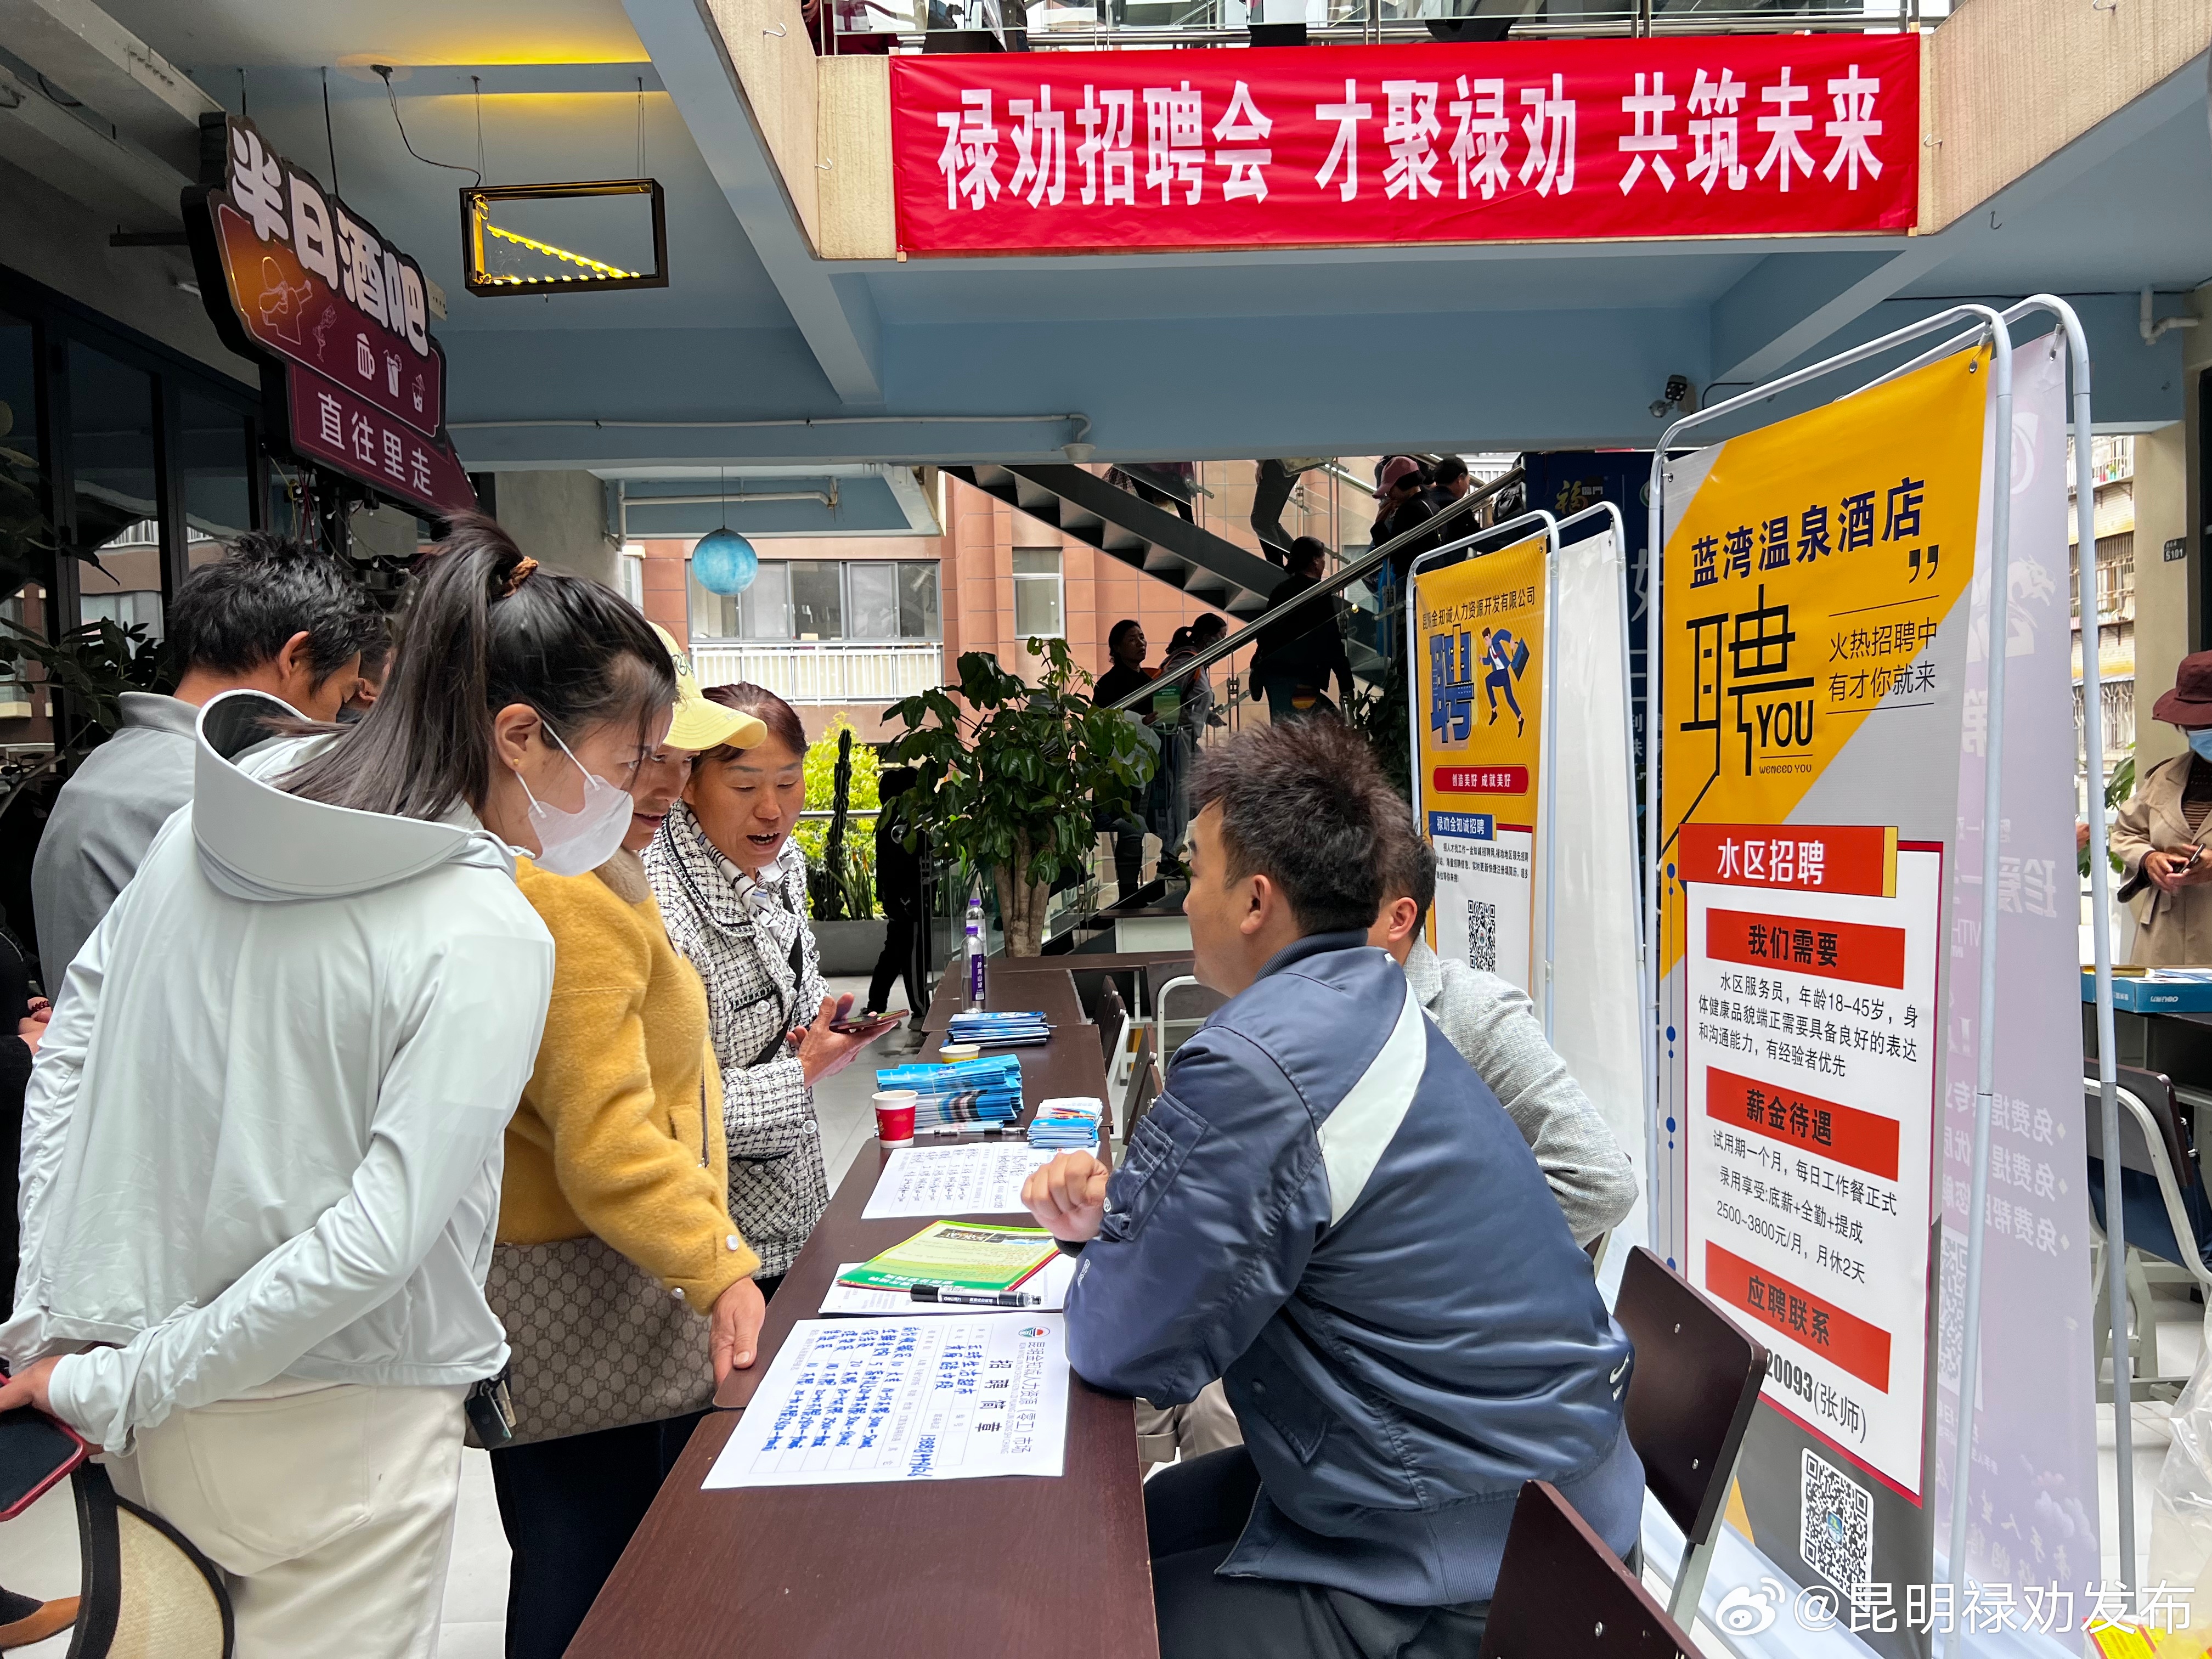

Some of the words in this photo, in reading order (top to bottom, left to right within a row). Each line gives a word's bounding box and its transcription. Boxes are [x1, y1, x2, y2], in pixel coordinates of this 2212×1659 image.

[936, 78, 1274, 211] 禄劝招聘会
[1314, 75, 1577, 201] 才聚禄劝
[1618, 64, 1883, 195] 共筑未来
[233, 127, 430, 357] 半日酒吧
[318, 391, 433, 496] 直往里走
[1690, 476, 1925, 589] 蓝湾温泉酒店
[1829, 617, 1937, 662] 火热招聘中
[1429, 624, 1474, 743] 聘
[1680, 584, 1814, 776] 聘
[1827, 661, 1936, 702] 有才你就来
[1756, 699, 1814, 748] YOU
[1452, 774, 1477, 787] 创造美好
[1481, 774, 1511, 787] 成就美好
[1795, 764, 1812, 774] YOU
[1437, 816, 1485, 835] 禄劝金知诚招聘
[1717, 837, 1824, 885] 水区招聘
[1748, 924, 1838, 968] 我们需要
[1699, 994, 1917, 1062] 体健康品貌端正需要具备良好的表达
[1699, 1022, 1846, 1077] 和沟通能力，有经验者优先
[1747, 1088, 1832, 1147] 薪金待遇
[1713, 1130, 1898, 1216] 试用期一个月，每日工作餐正式
[1747, 1275, 1831, 1347] 应聘联系
[976, 1359, 1013, 1432] 招聘简章
